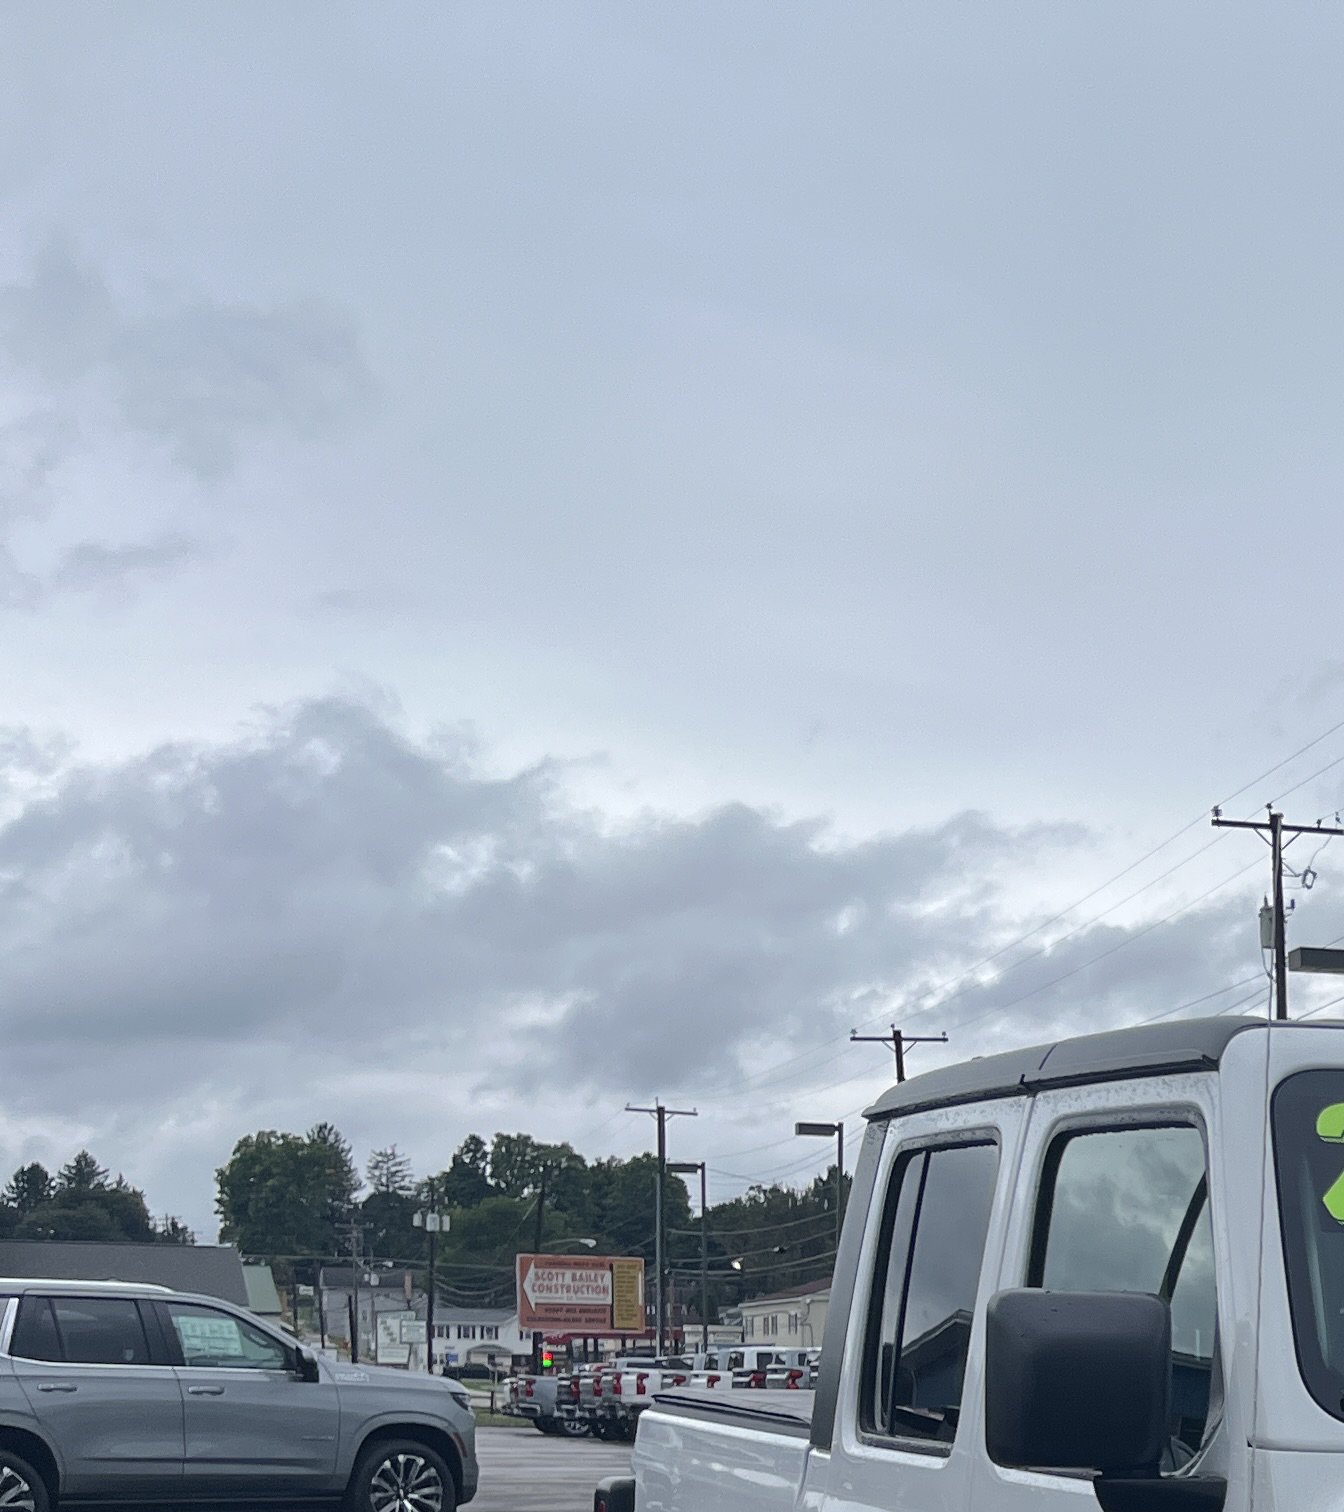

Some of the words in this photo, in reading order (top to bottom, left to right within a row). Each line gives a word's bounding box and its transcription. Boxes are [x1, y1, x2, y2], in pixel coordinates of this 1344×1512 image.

[534, 1271, 566, 1282] SCOTT
[571, 1272, 606, 1283] BAILEY
[531, 1283, 609, 1296] CONSTRUCTION
